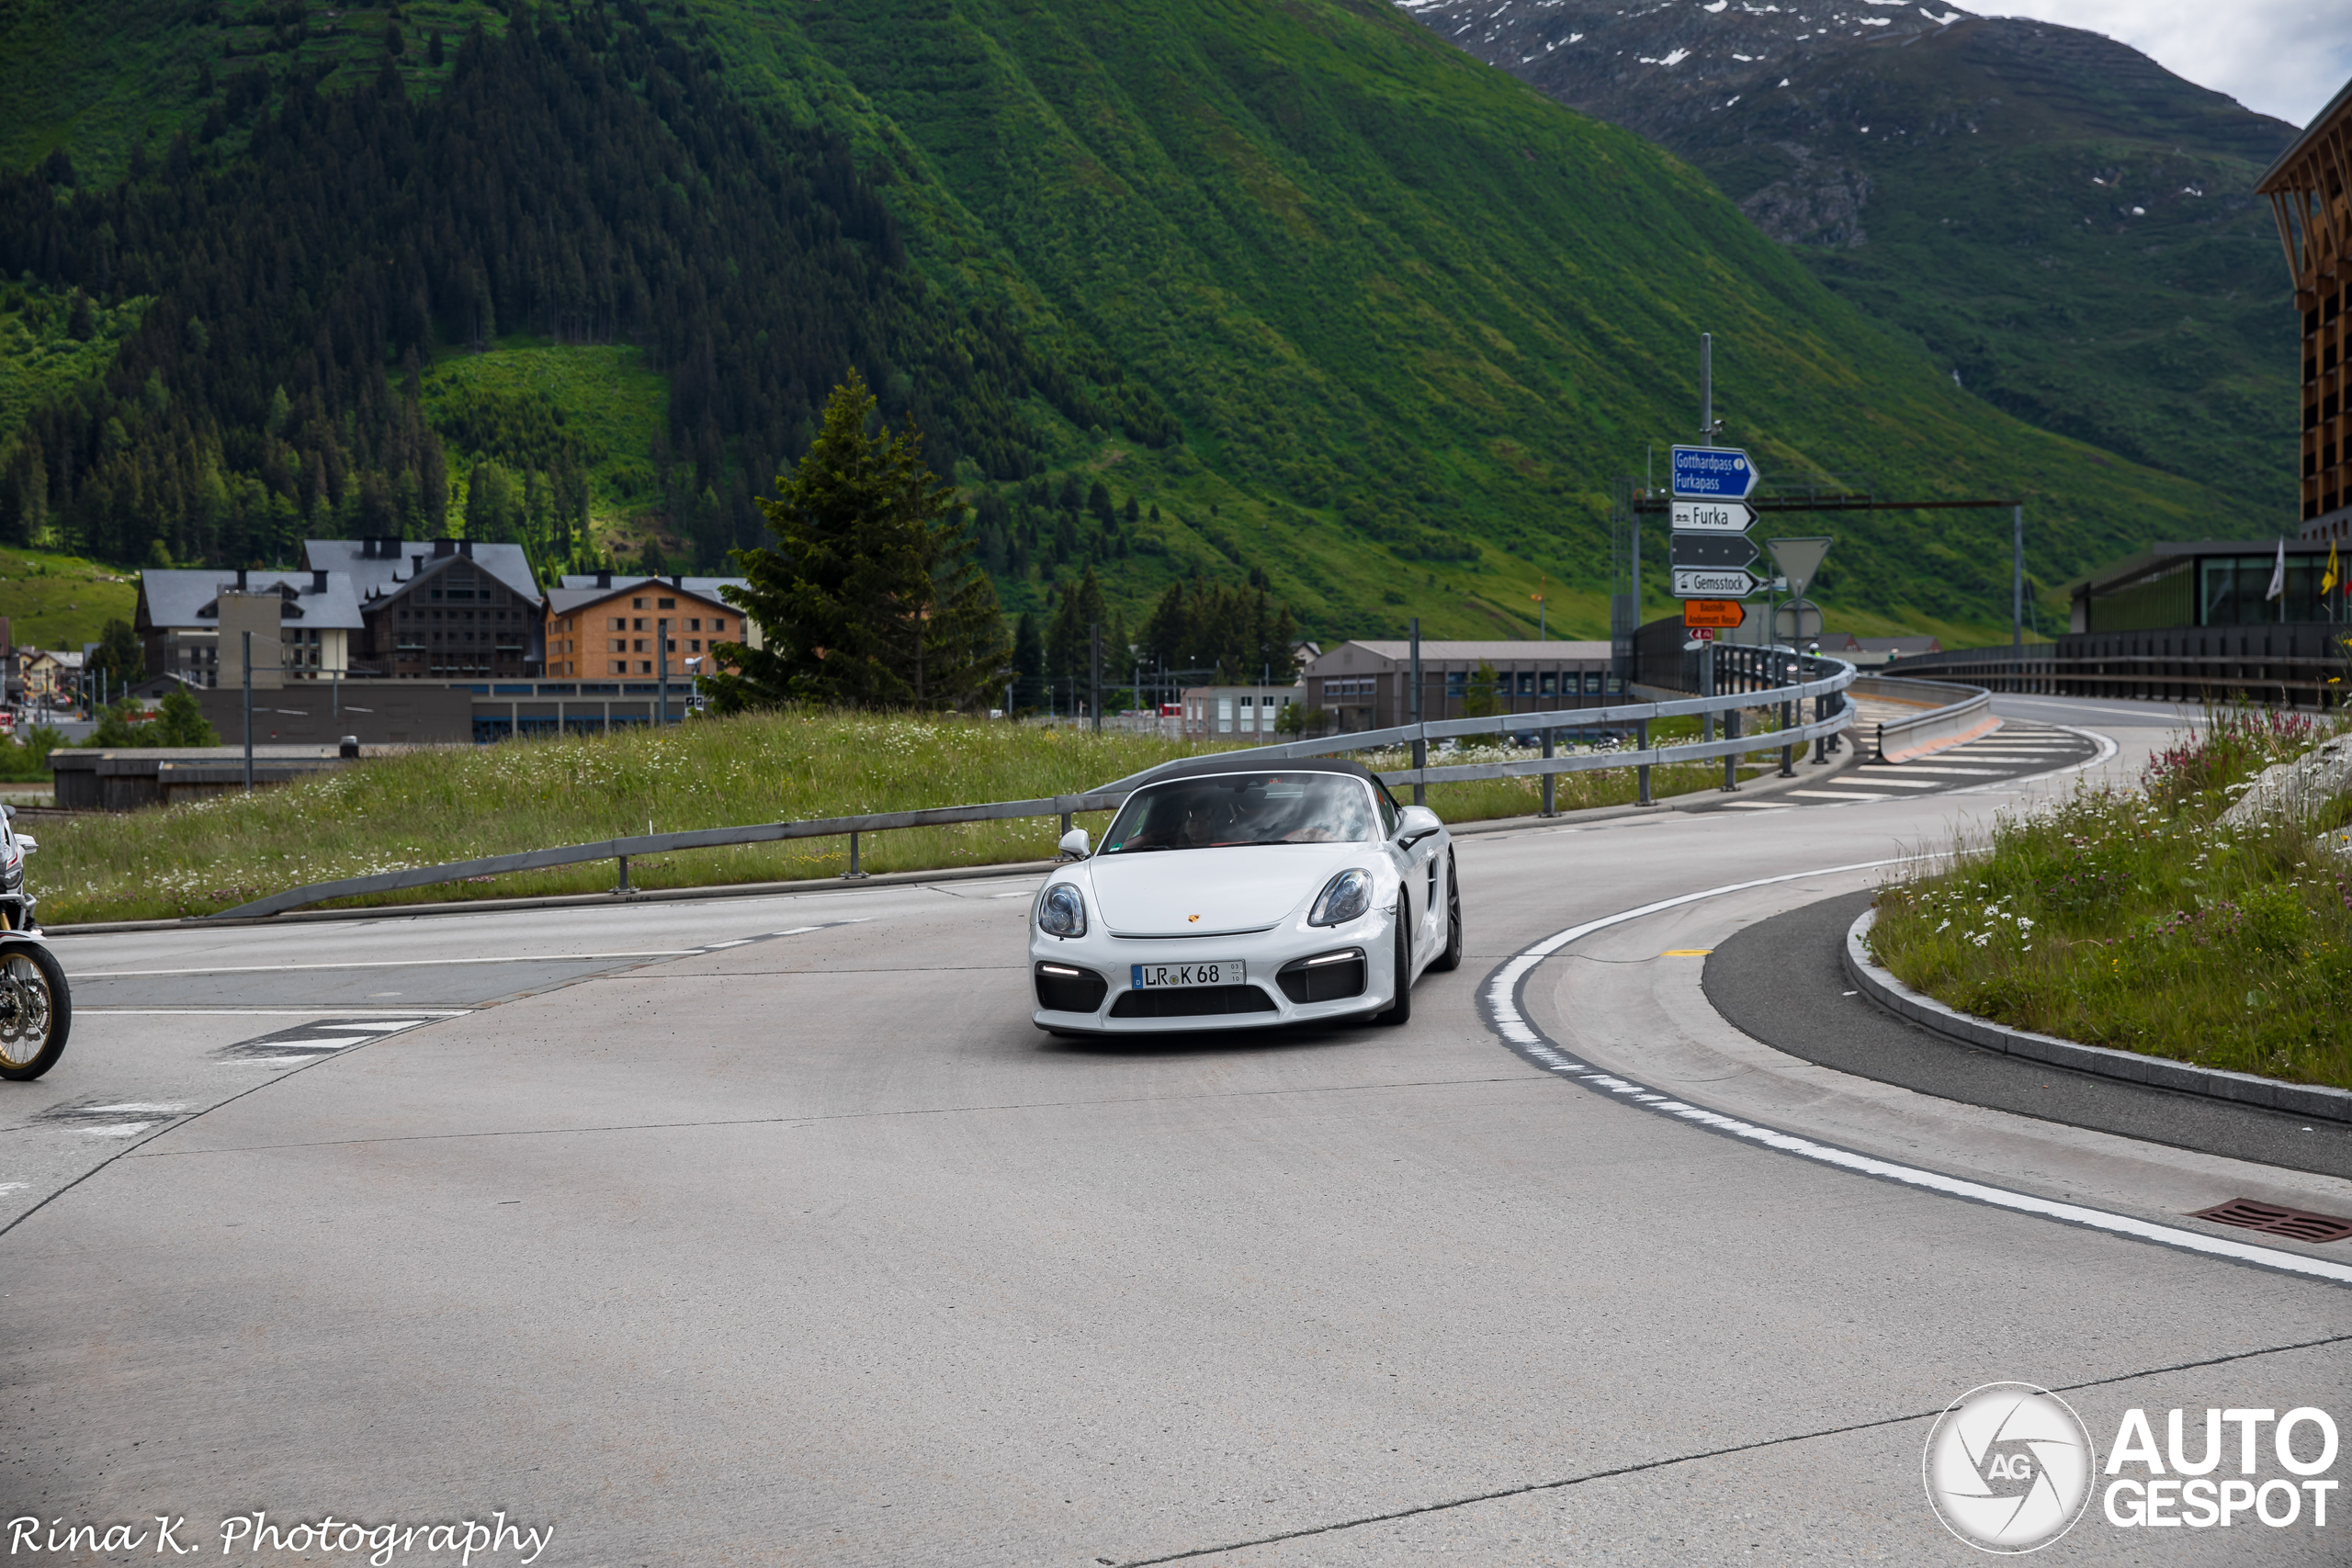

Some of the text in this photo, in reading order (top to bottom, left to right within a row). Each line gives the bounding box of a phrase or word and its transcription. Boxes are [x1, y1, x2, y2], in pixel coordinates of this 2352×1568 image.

[1676, 453, 1733, 474] Gotthardpass
[1676, 473, 1720, 493] Furkapass
[1693, 507, 1728, 525] Furka
[1694, 575, 1744, 591] Gemsstock
[1145, 964, 1220, 986] LR K 68
